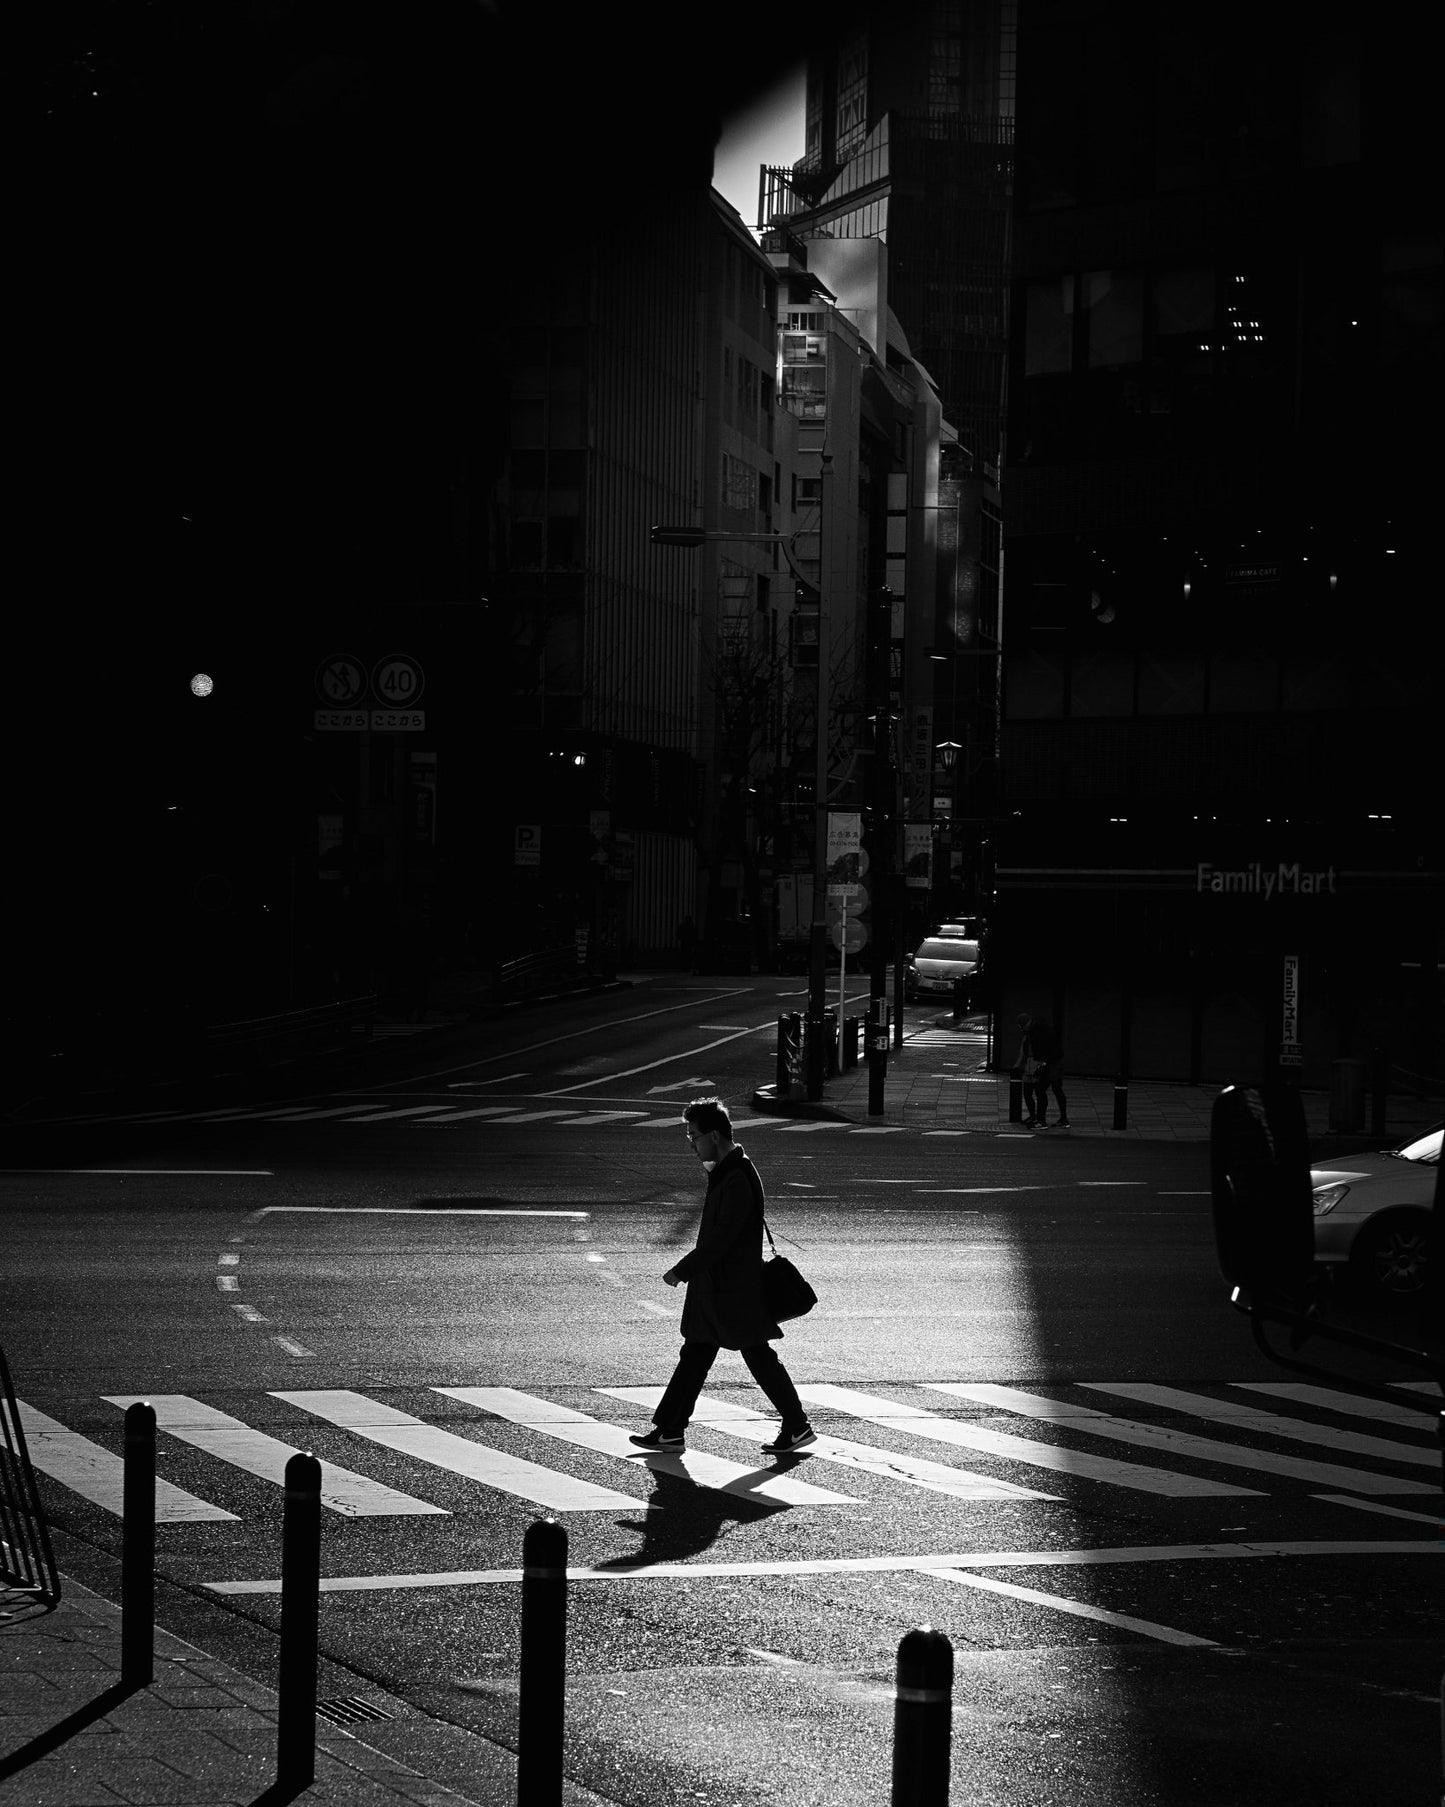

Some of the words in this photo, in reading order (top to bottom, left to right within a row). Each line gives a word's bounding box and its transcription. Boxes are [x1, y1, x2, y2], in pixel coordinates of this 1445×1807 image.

[384, 669, 412, 694] 40
[318, 714, 365, 727] ここから
[375, 714, 422, 727] ここから
[518, 828, 534, 848] P
[1196, 862, 1337, 902] FamilyMart
[1282, 959, 1297, 1042] FamilyMart
